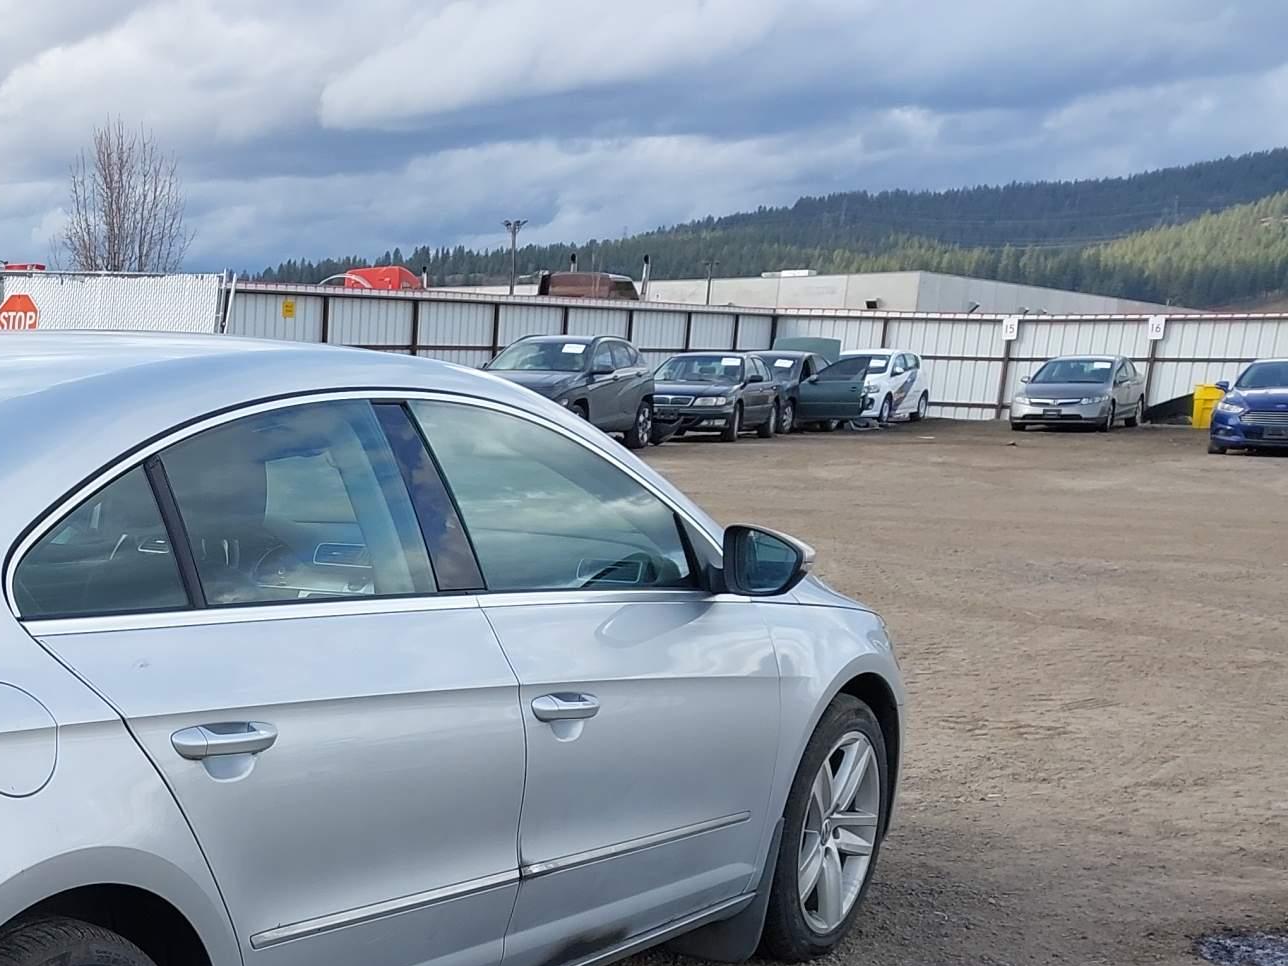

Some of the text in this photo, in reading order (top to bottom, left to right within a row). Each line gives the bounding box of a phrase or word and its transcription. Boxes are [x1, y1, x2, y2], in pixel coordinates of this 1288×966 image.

[0, 311, 36, 331] STOP
[1005, 323, 1015, 334] 15
[1151, 323, 1161, 333] 16
